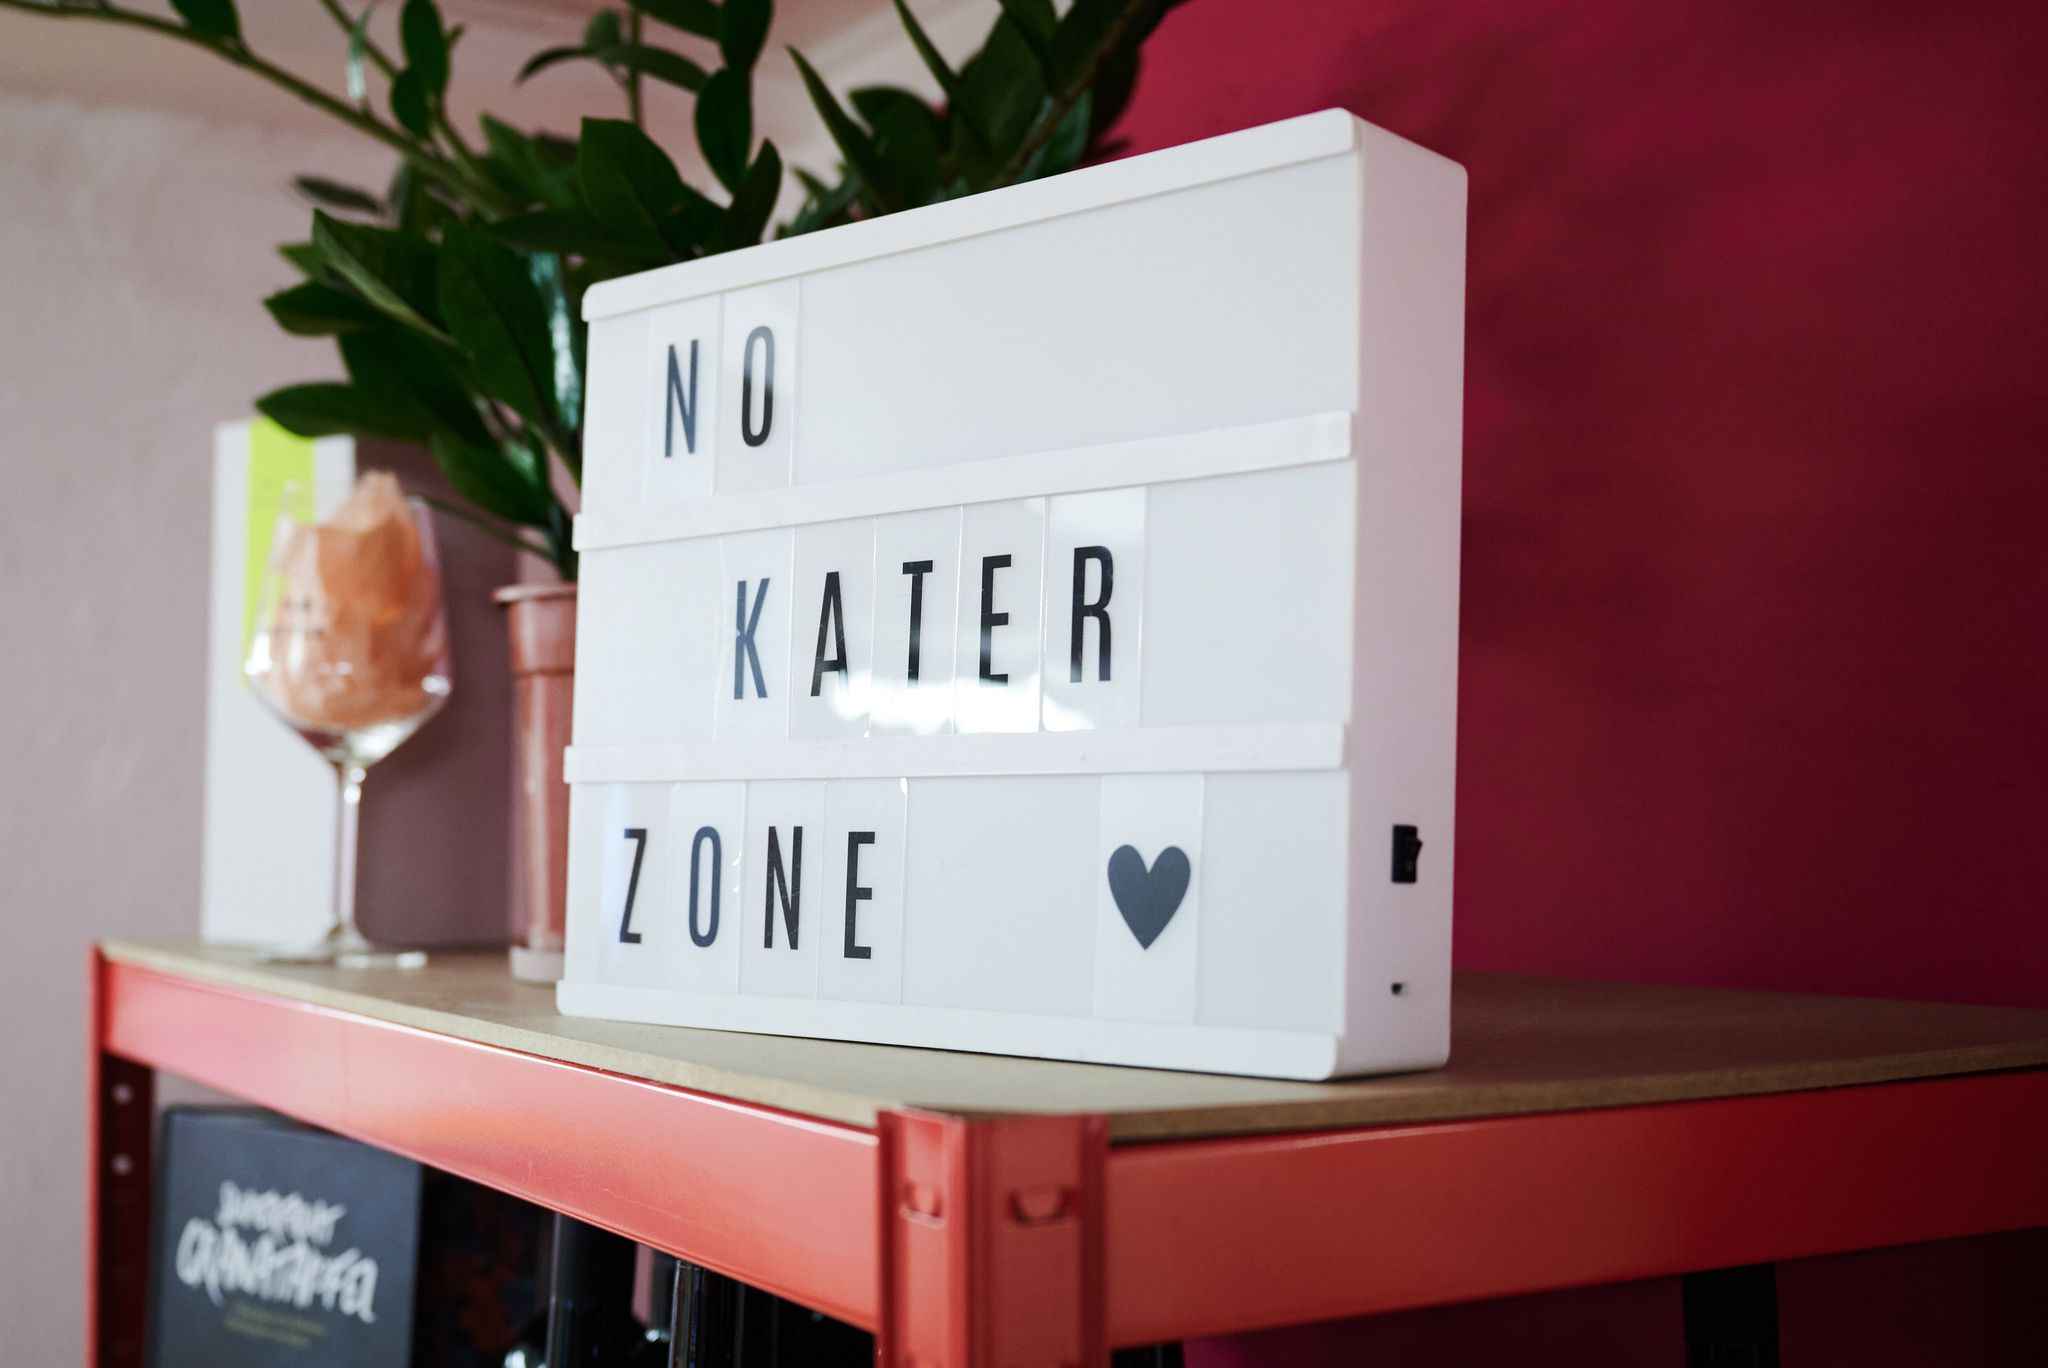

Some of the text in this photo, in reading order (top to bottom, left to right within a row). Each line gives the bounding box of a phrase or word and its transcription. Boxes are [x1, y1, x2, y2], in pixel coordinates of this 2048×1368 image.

[665, 325, 775, 458] NO
[733, 545, 1114, 700] KATER
[619, 825, 876, 960] ZONE
